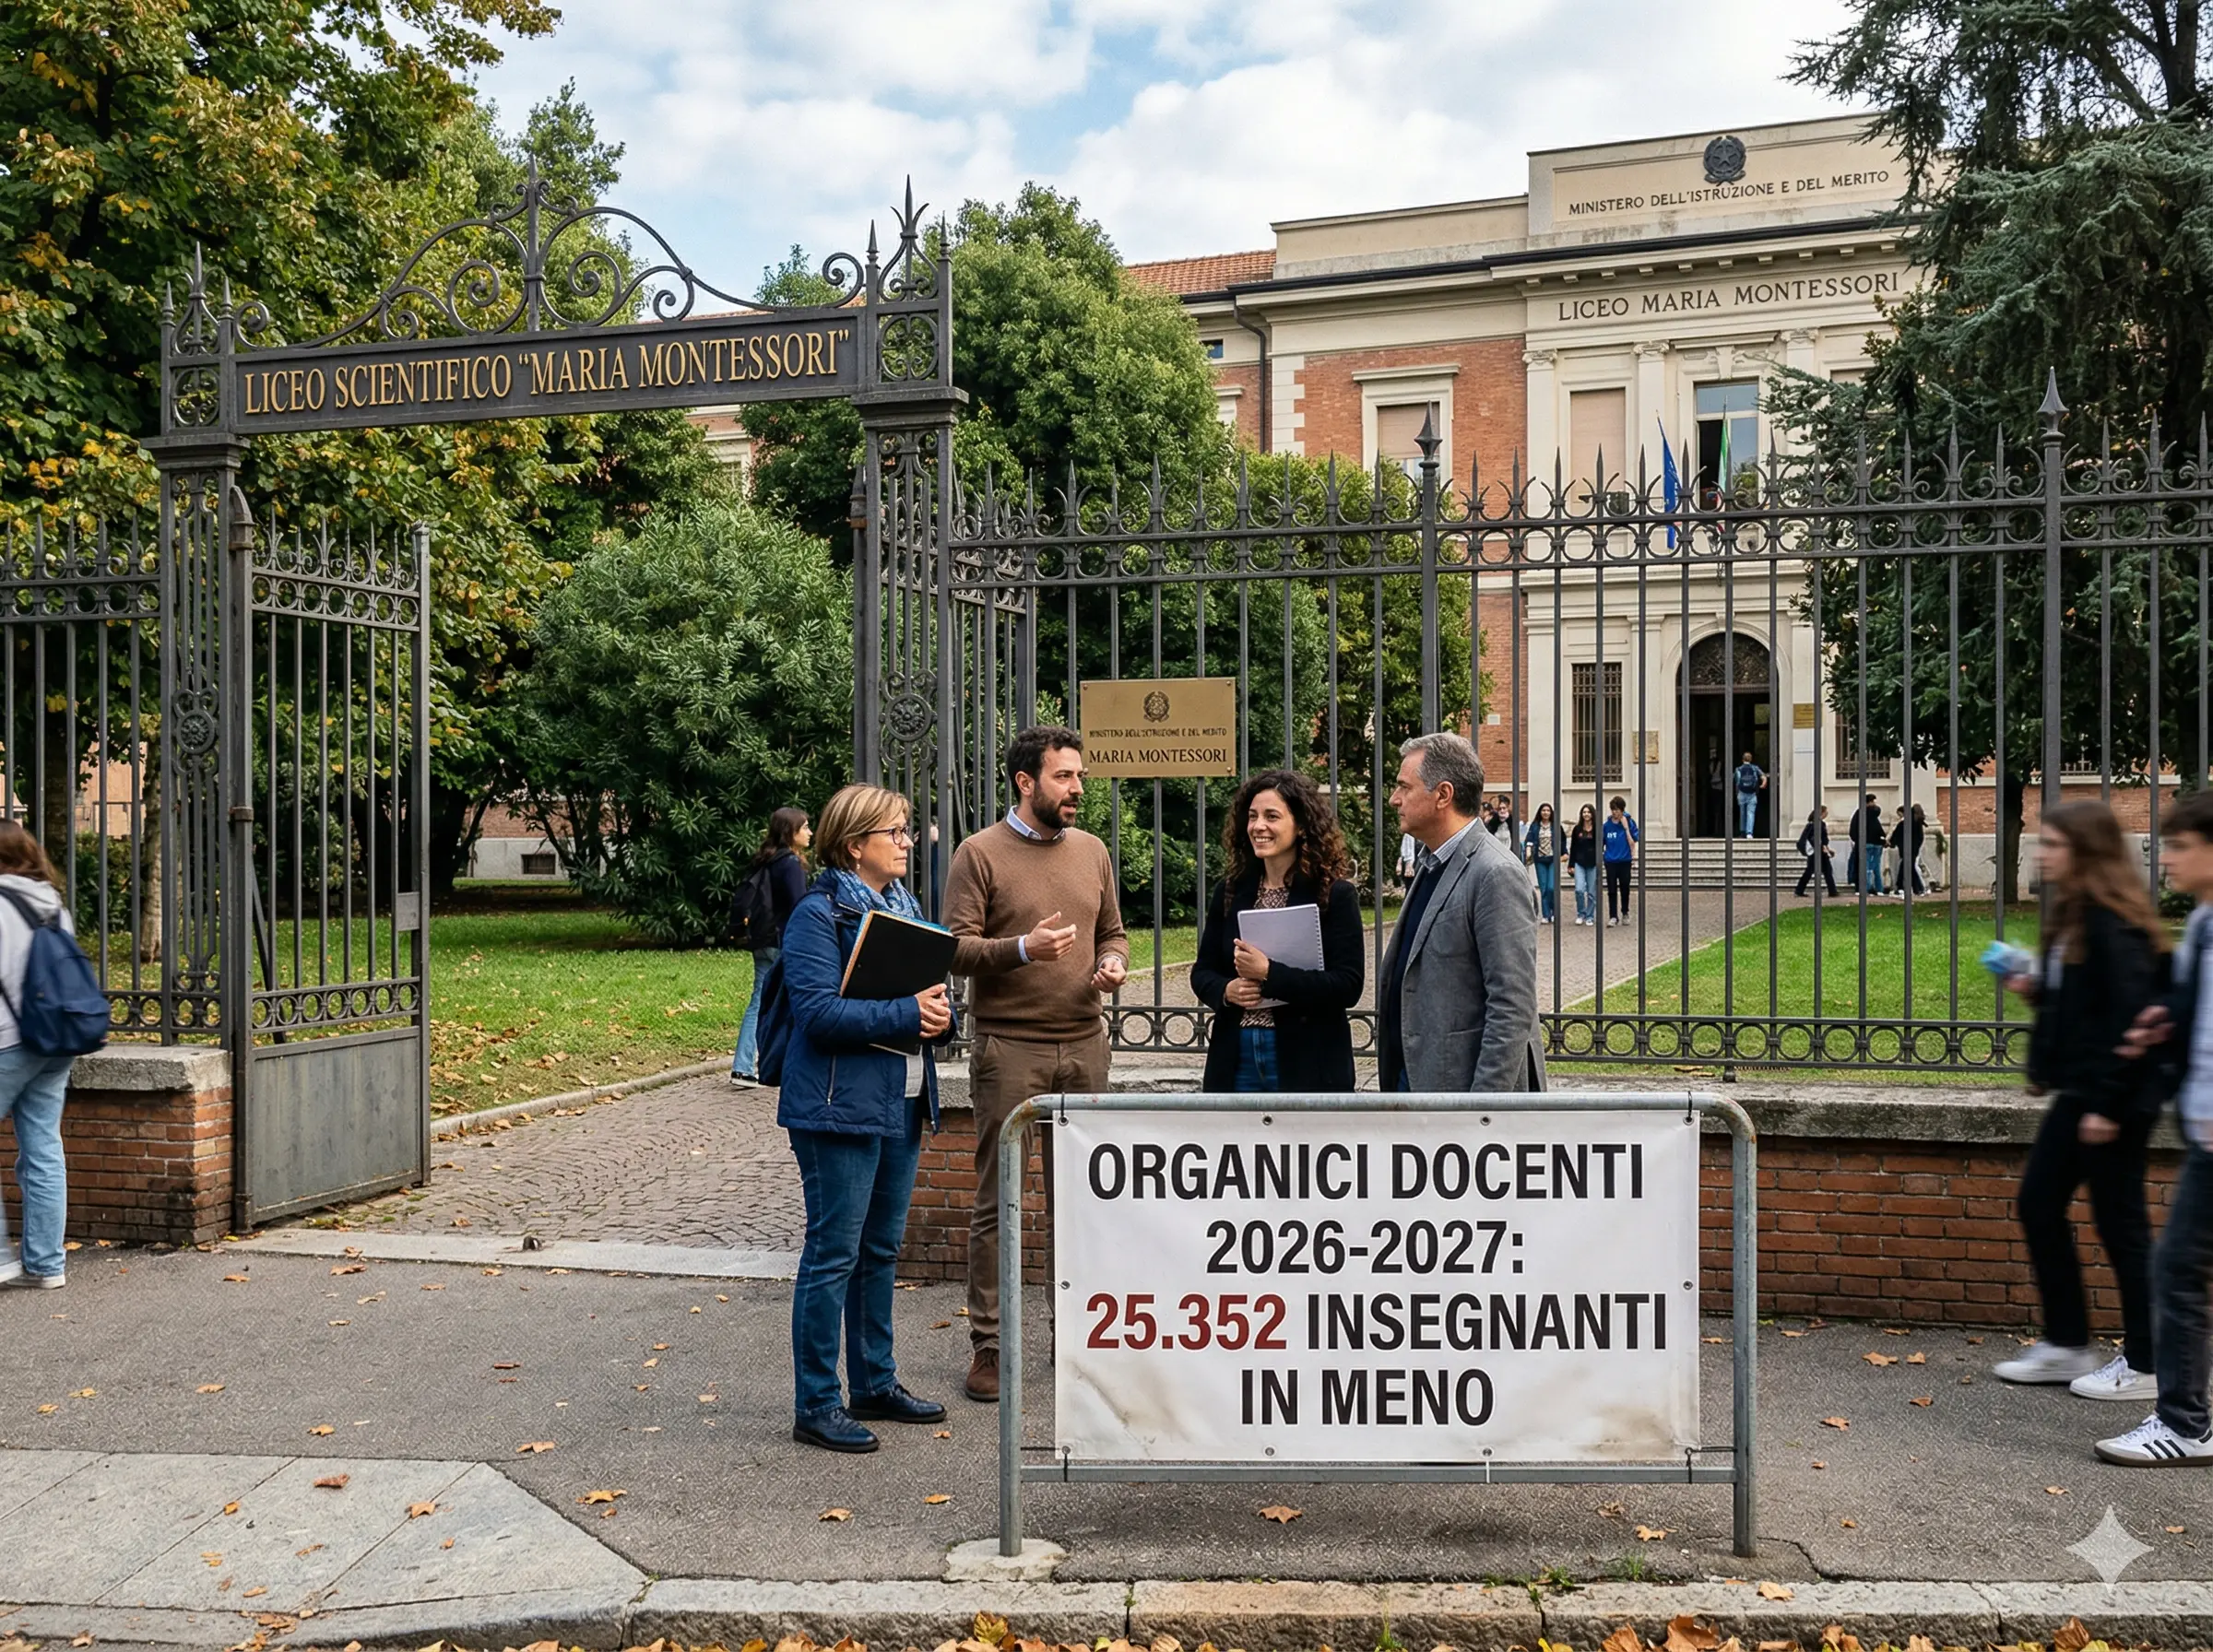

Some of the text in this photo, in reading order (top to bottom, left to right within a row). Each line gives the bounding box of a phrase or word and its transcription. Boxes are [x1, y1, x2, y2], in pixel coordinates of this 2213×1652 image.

[1568, 171, 1888, 215] MINISTERO DELL'ISTRUZIONE E DEL MERITO
[1559, 272, 1899, 321] LICEO MARIA MONTESSORI
[244, 328, 849, 414] LICEO SCIENTIFICO “MARIA MONTESSORI"
[1089, 749, 1226, 762] MARIA MONTESSORI
[1088, 1143, 1642, 1201] ORGANICI DOCENTI
[1206, 1220, 1523, 1274] 2026-2027:
[1086, 1293, 1666, 1351] 25.352 INSEGNANTI
[1242, 1369, 1494, 1426] IN MENO
